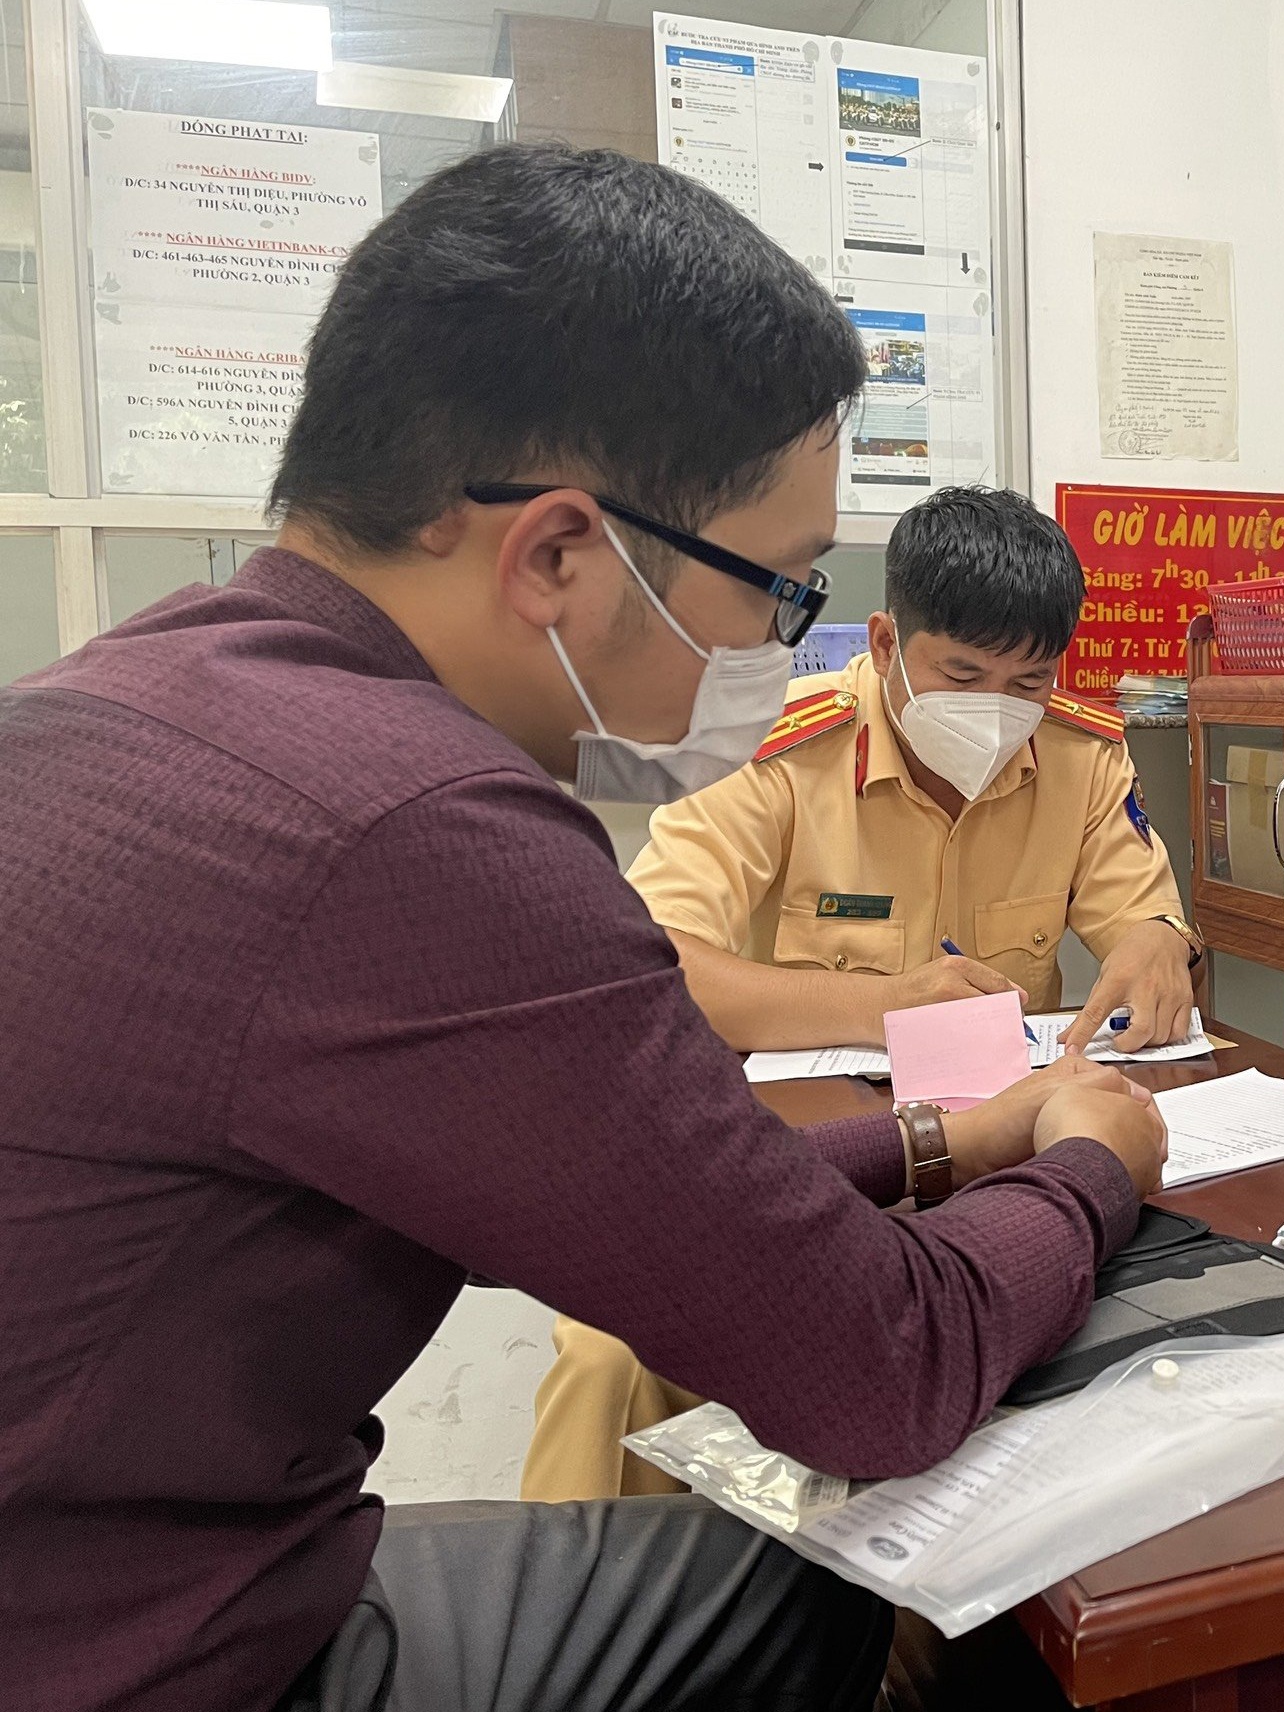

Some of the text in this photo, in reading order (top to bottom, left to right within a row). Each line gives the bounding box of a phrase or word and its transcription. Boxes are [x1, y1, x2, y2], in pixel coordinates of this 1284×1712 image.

[282, 172, 317, 185] BIDV:
[153, 179, 167, 190] 34
[293, 206, 300, 216] 3
[161, 251, 228, 265] 461-463-465
[304, 277, 310, 286] 3
[178, 365, 220, 376] 614-616
[156, 397, 185, 408] 596A
[280, 419, 288, 428] 3
[158, 430, 177, 441] 226
[1093, 501, 1150, 546] GIỜ
[1154, 504, 1217, 548] LÀM
[1083, 566, 1143, 591] Sáng:
[1079, 600, 1165, 623] Chiều:
[1075, 637, 1172, 658] Thứ 7: Từ
